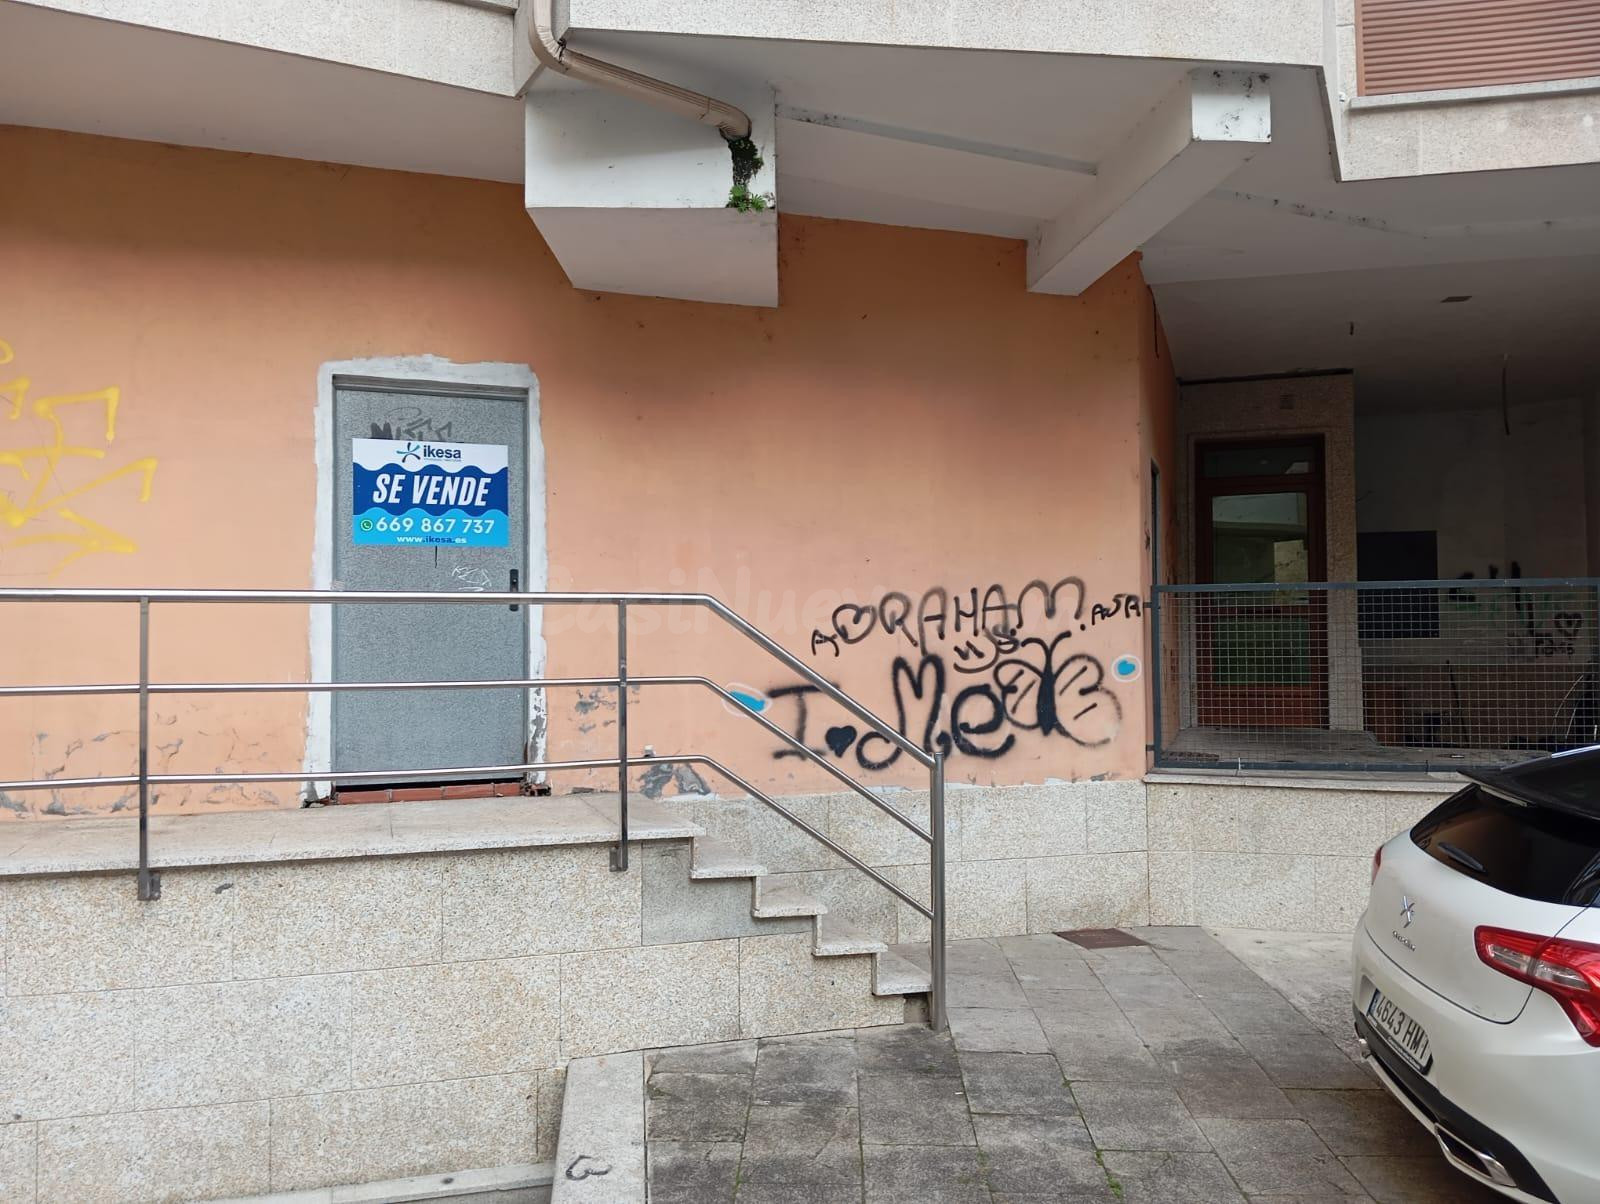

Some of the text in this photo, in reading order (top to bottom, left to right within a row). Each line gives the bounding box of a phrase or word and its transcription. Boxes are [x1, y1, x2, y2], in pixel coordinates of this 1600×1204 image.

[423, 445, 462, 459] ikesa
[372, 473, 492, 507] SE VENDE
[375, 517, 495, 534] 669 867 737
[396, 535, 467, 544] www.ikesa.es
[1376, 995, 1406, 1035] 4643
